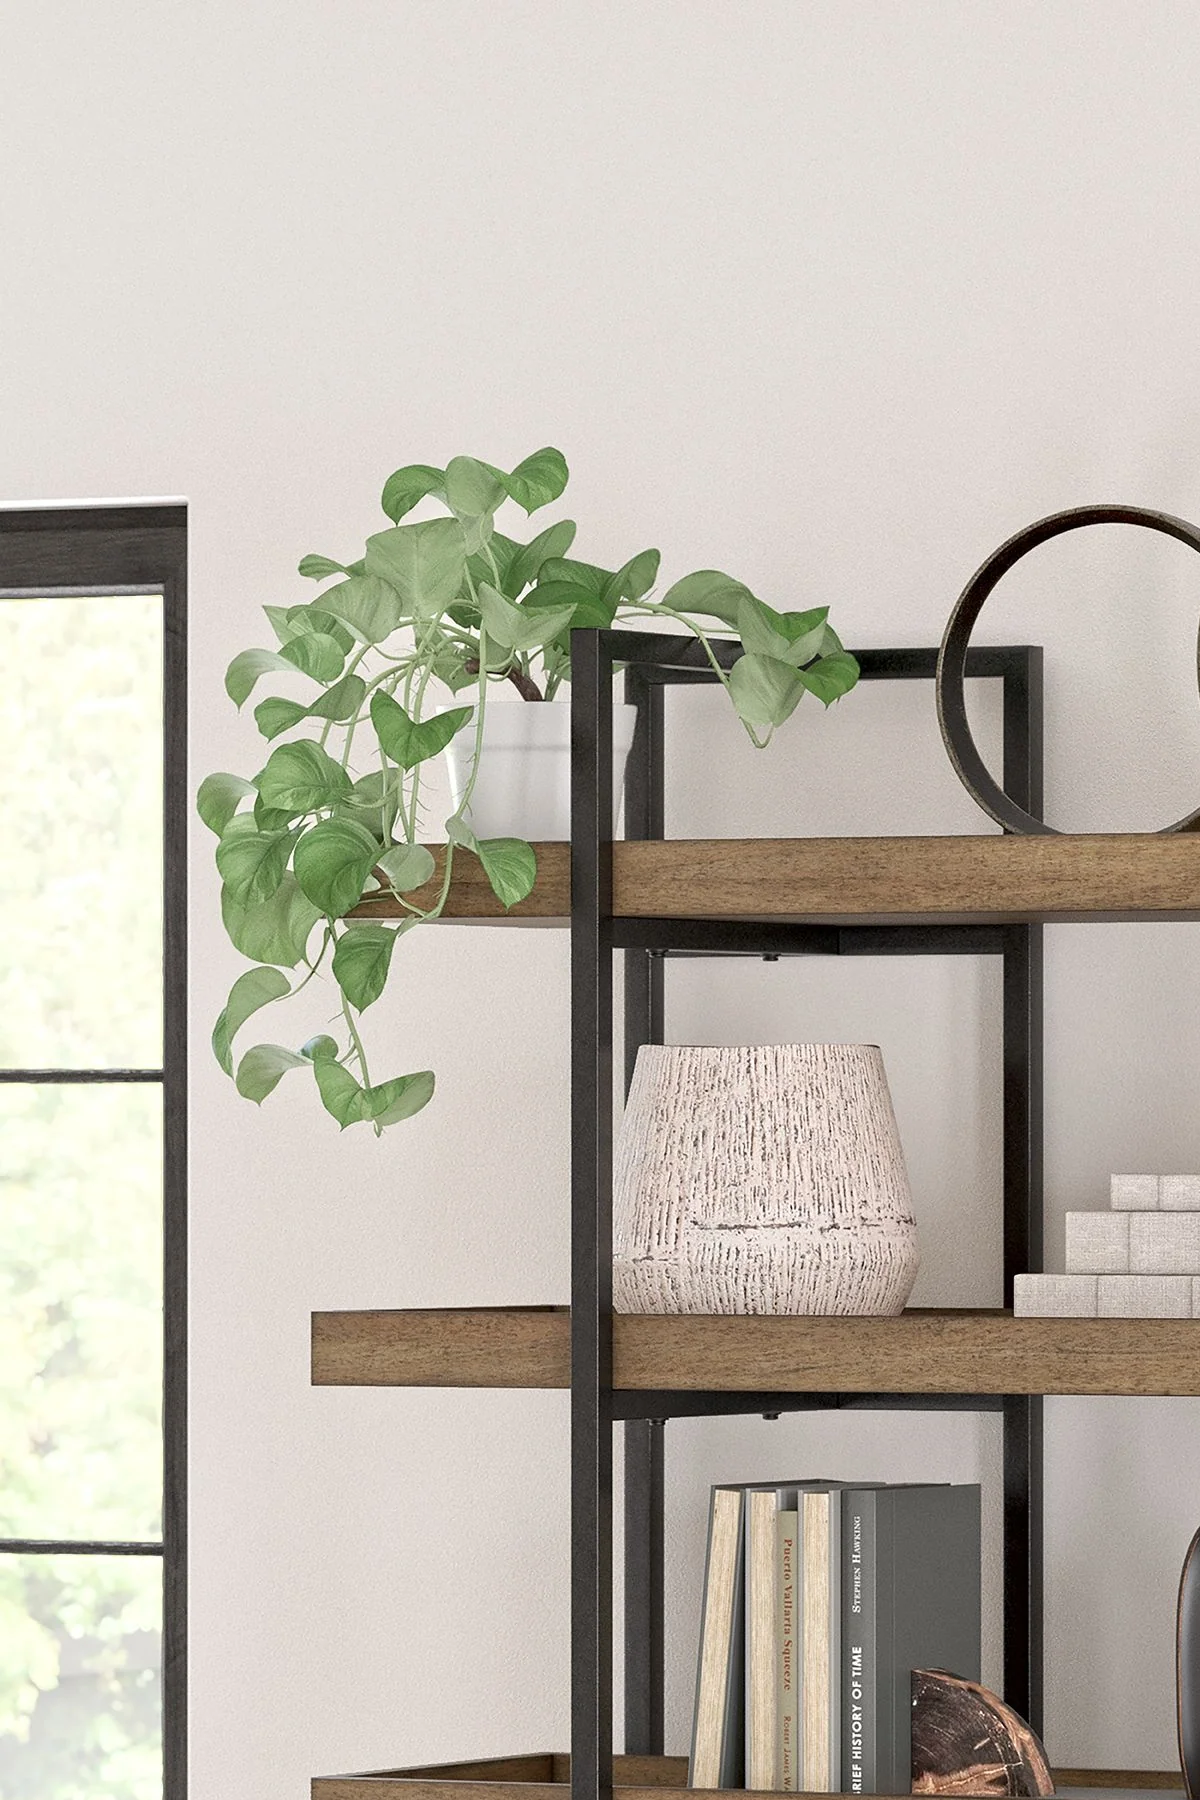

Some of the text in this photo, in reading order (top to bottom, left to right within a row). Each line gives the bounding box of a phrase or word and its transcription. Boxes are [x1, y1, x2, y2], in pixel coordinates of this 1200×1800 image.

[782, 1539, 793, 1690] Puerto Vallarta Squeeze
[852, 1647, 862, 1794] RIEF HISTORY OF TIME
